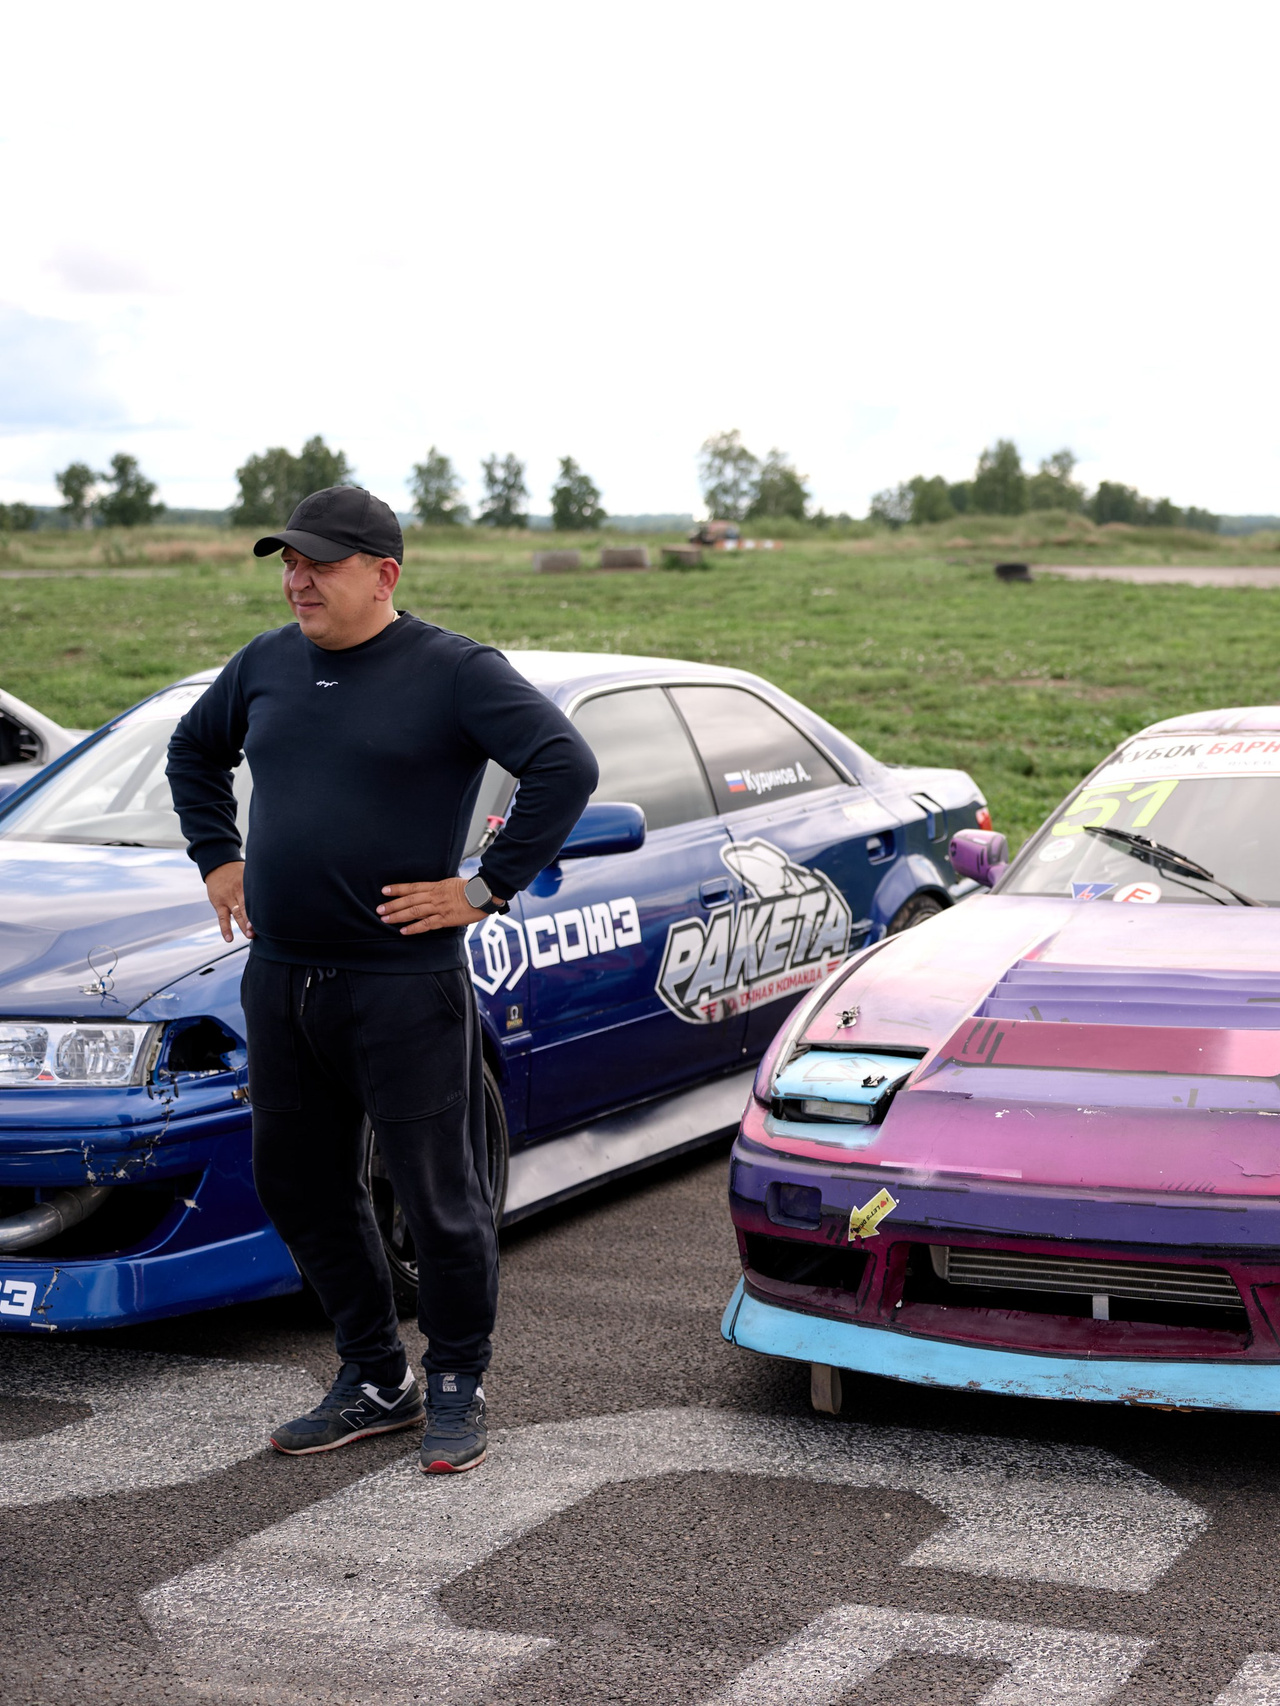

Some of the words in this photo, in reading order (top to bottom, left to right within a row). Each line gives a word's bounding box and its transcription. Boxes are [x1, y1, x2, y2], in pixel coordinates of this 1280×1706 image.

[741, 767, 797, 795] Кудинов
[1051, 779, 1180, 837] 51
[524, 896, 642, 970] СОЮЗ
[660, 887, 849, 1005] РАКЕТА
[775, 967, 823, 994] КОМАНДА
